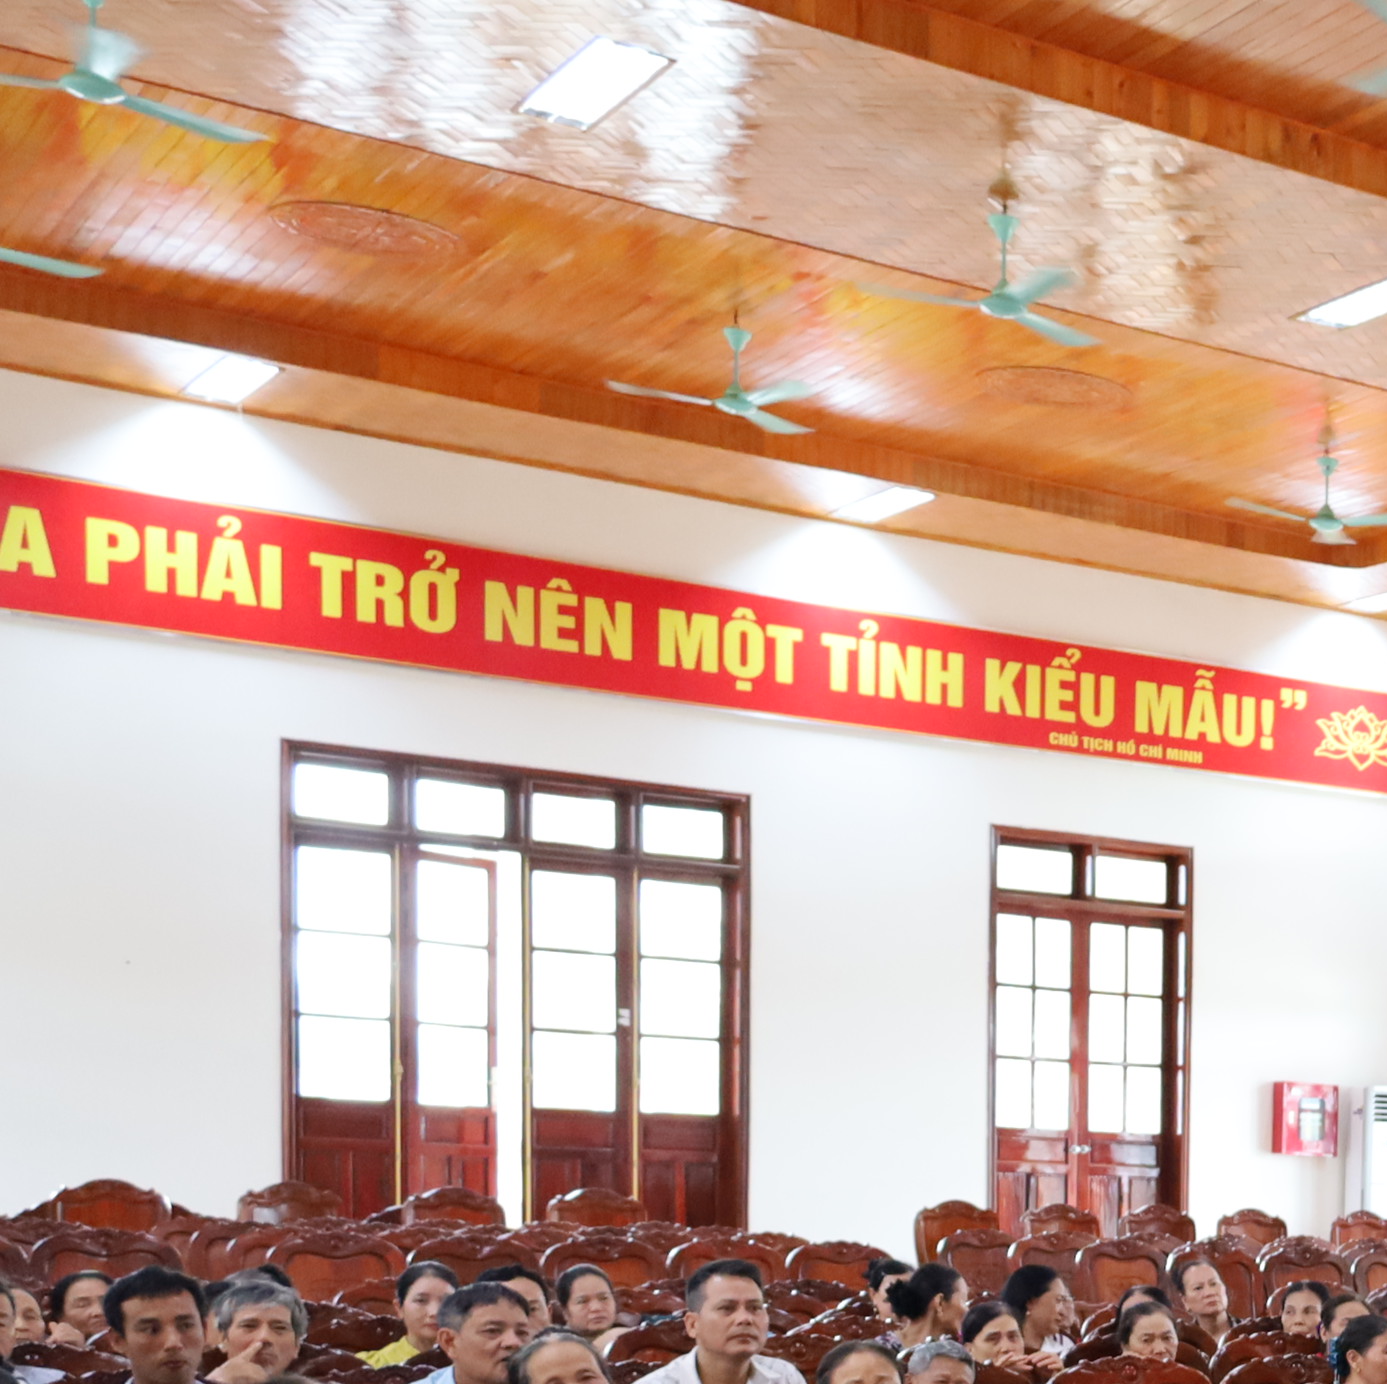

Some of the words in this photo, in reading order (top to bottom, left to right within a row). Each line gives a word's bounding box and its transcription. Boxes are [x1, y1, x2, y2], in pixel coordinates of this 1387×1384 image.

[0, 505, 57, 578] A
[85, 515, 283, 610] PHẢI
[309, 549, 460, 634] TRỞ
[484, 578, 633, 661] NÊN
[658, 607, 804, 691] MỘT
[820, 619, 964, 708] TỈNH
[985, 647, 1115, 727] KIỂU
[1049, 731, 1079, 747] CHỦ
[1082, 736, 1114, 752] TỊCH
[1166, 747, 1204, 764] MINH
